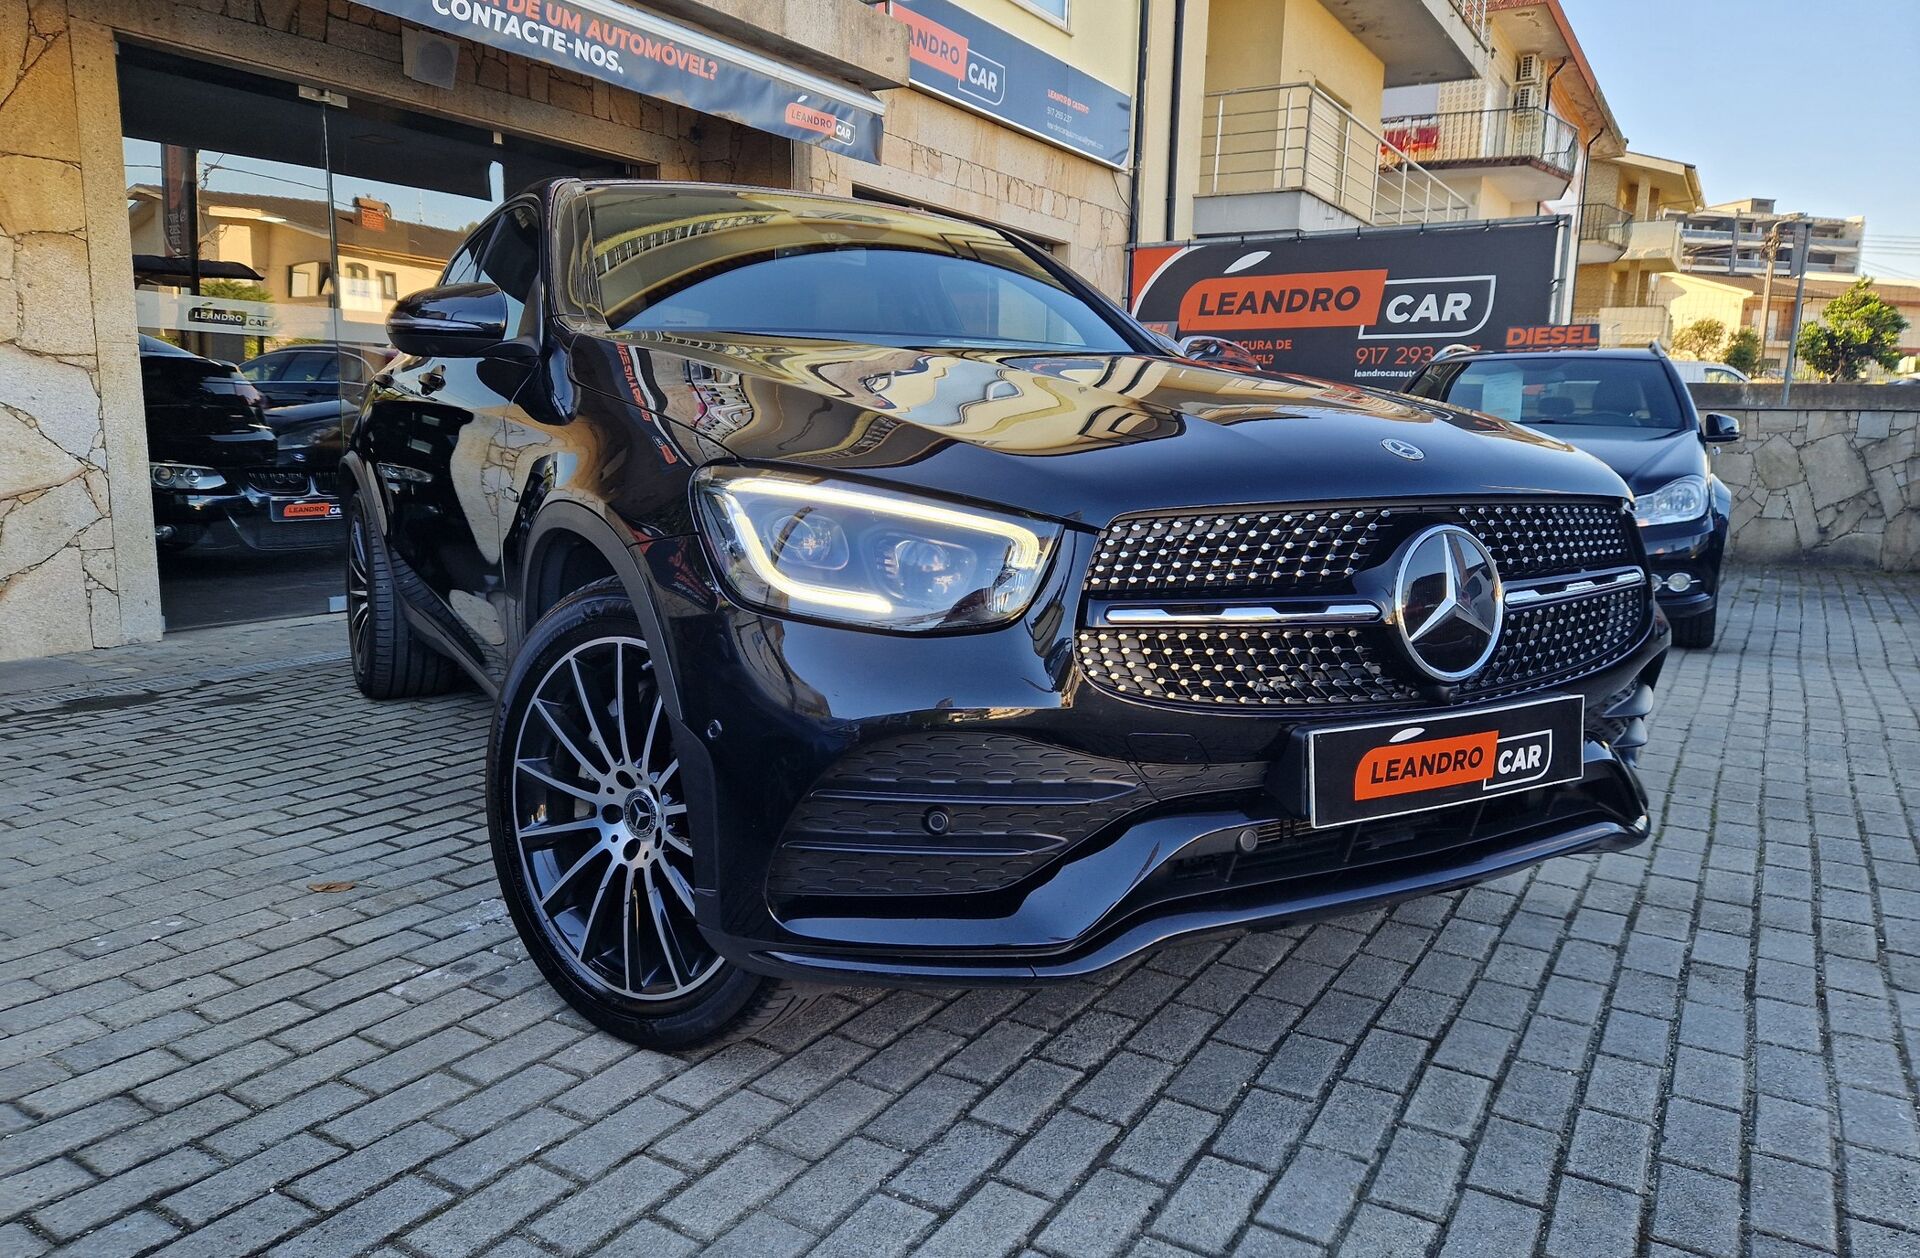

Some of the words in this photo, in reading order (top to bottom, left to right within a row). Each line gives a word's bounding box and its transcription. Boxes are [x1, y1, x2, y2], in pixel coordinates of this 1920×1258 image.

[432, 0, 624, 74] CONTACTE-NOS.
[506, 0, 541, 20] DE
[546, 3, 582, 34] UM
[586, 20, 718, 81] AUTOMÓVEL?
[908, 25, 960, 65] ANDRO
[968, 63, 997, 93] CAR
[791, 109, 832, 129] LEANDRO
[836, 125, 851, 140] CAR
[195, 311, 242, 322] LEANDRO
[249, 319, 268, 327] CAR
[1198, 286, 1361, 316] LEANDRO
[1386, 293, 1472, 324] CAR
[1276, 340, 1292, 350] DE
[1505, 326, 1598, 346] DIESEL
[1356, 347, 1389, 365] 917
[1395, 346, 1434, 364] 293
[288, 505, 325, 514] LEANDRO
[1371, 746, 1484, 784] LEANDRO
[1497, 745, 1542, 775] CAR
